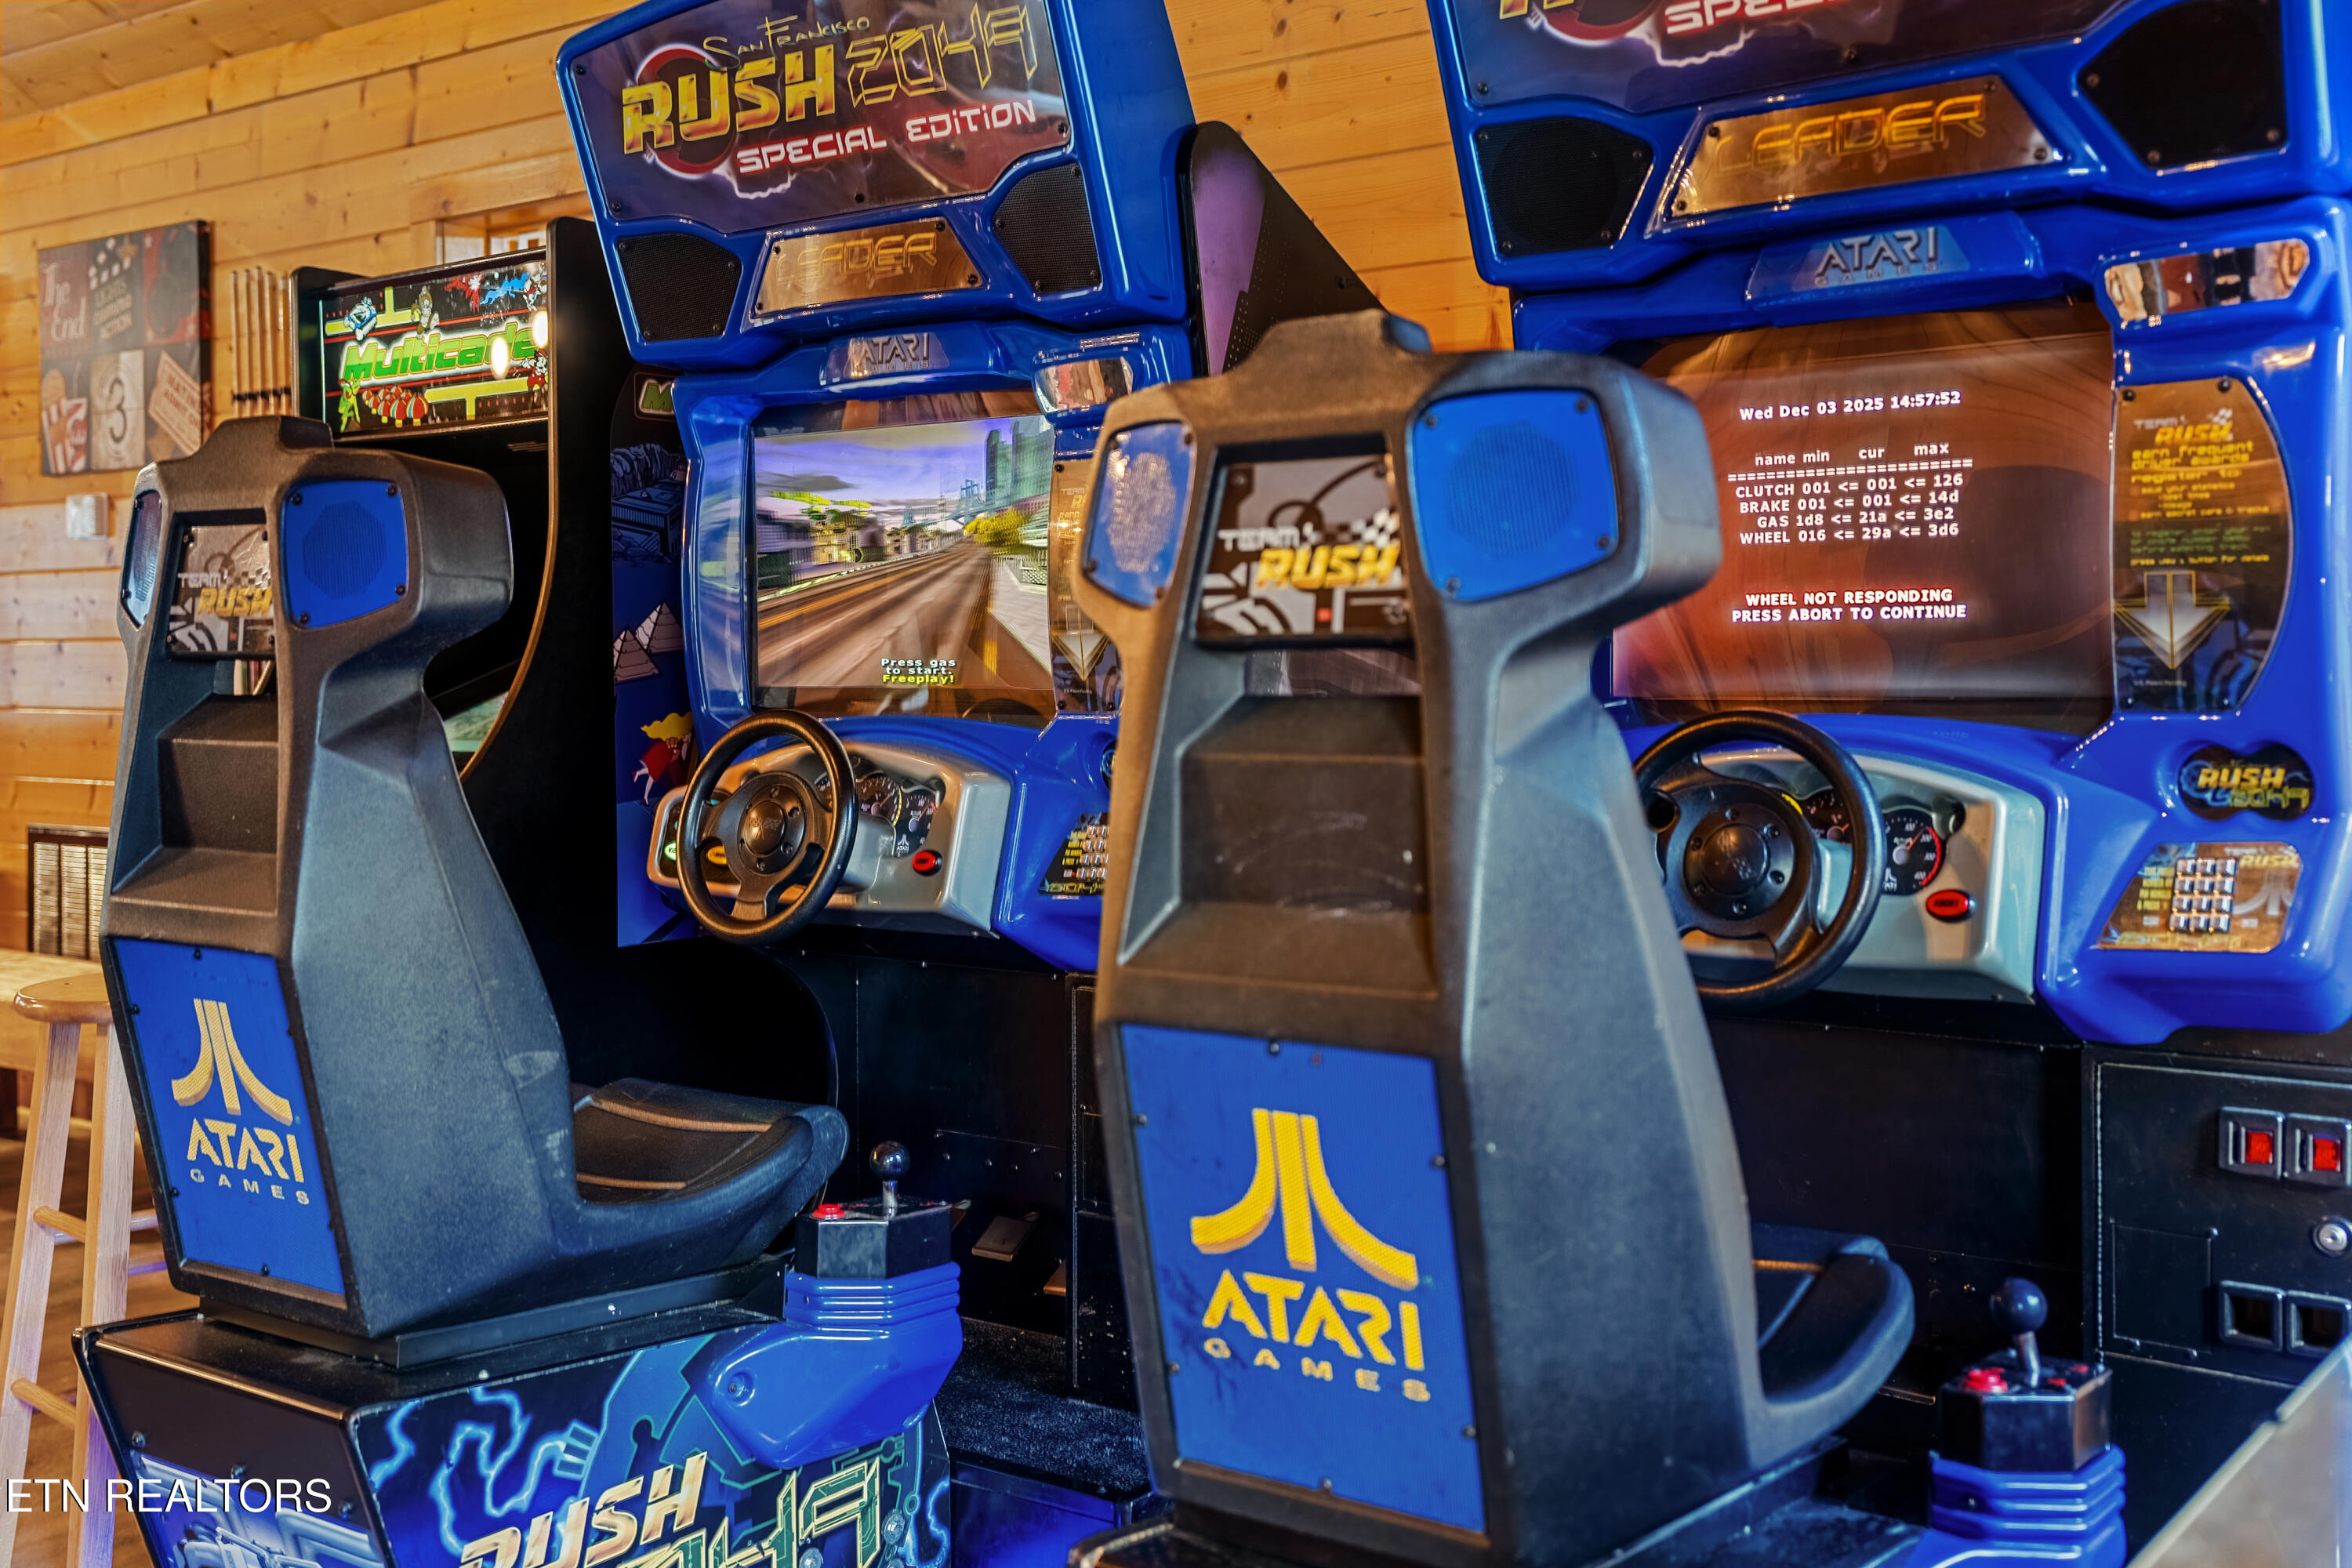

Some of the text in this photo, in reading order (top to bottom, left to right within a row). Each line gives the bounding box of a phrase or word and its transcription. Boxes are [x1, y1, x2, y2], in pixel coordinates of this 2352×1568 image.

[622, 45, 836, 155] RUSH
[736, 125, 888, 174] SPECIAL
[1815, 227, 1938, 277] ATARI
[42, 263, 71, 307] The
[51, 296, 87, 342] End
[342, 321, 539, 381] Multicade
[109, 376, 127, 443] 3
[1739, 390, 1961, 421] Wed Dec 03 2025 14:57:52
[2154, 421, 2233, 445] RUSH
[1755, 443, 1949, 466] name min cur max
[2132, 441, 2253, 459] earn frequent
[1735, 483, 1795, 499] CLUTCH
[1802, 481, 1831, 495] 001
[1866, 477, 1897, 491] 001
[1933, 473, 1963, 488] 126
[1740, 499, 1790, 514] BRAKE
[1797, 497, 1827, 510] 001
[1862, 493, 1892, 508] 001
[1929, 489, 1959, 504] 14d
[1757, 514, 1789, 528] GAS
[1796, 513, 1824, 527] 1d8
[1859, 510, 1887, 524] 21a
[1923, 506, 1954, 521] 3e2
[1218, 525, 1300, 550] TEAM
[1739, 531, 1791, 545] WHEEL
[1798, 528, 1826, 543] 016
[1862, 526, 1892, 539] 29a
[1928, 522, 1959, 536] 3d6
[1255, 539, 1400, 590] RUSH
[177, 573, 220, 588] TEAM
[198, 586, 273, 618] RUSH
[1745, 588, 1953, 607] WHEEL NOT RESPONDING
[1732, 604, 1966, 622] PRESS ABORT TO CONTINUE
[881, 658, 956, 668] Press gas
[883, 674, 954, 685] Freeplay!
[2198, 768, 2286, 789] RUSH
[187, 1117, 305, 1183] ATARI
[190, 1169, 310, 1205] GAMES
[1202, 1269, 1425, 1371] ATARI
[1203, 1337, 1431, 1402] GAMES
